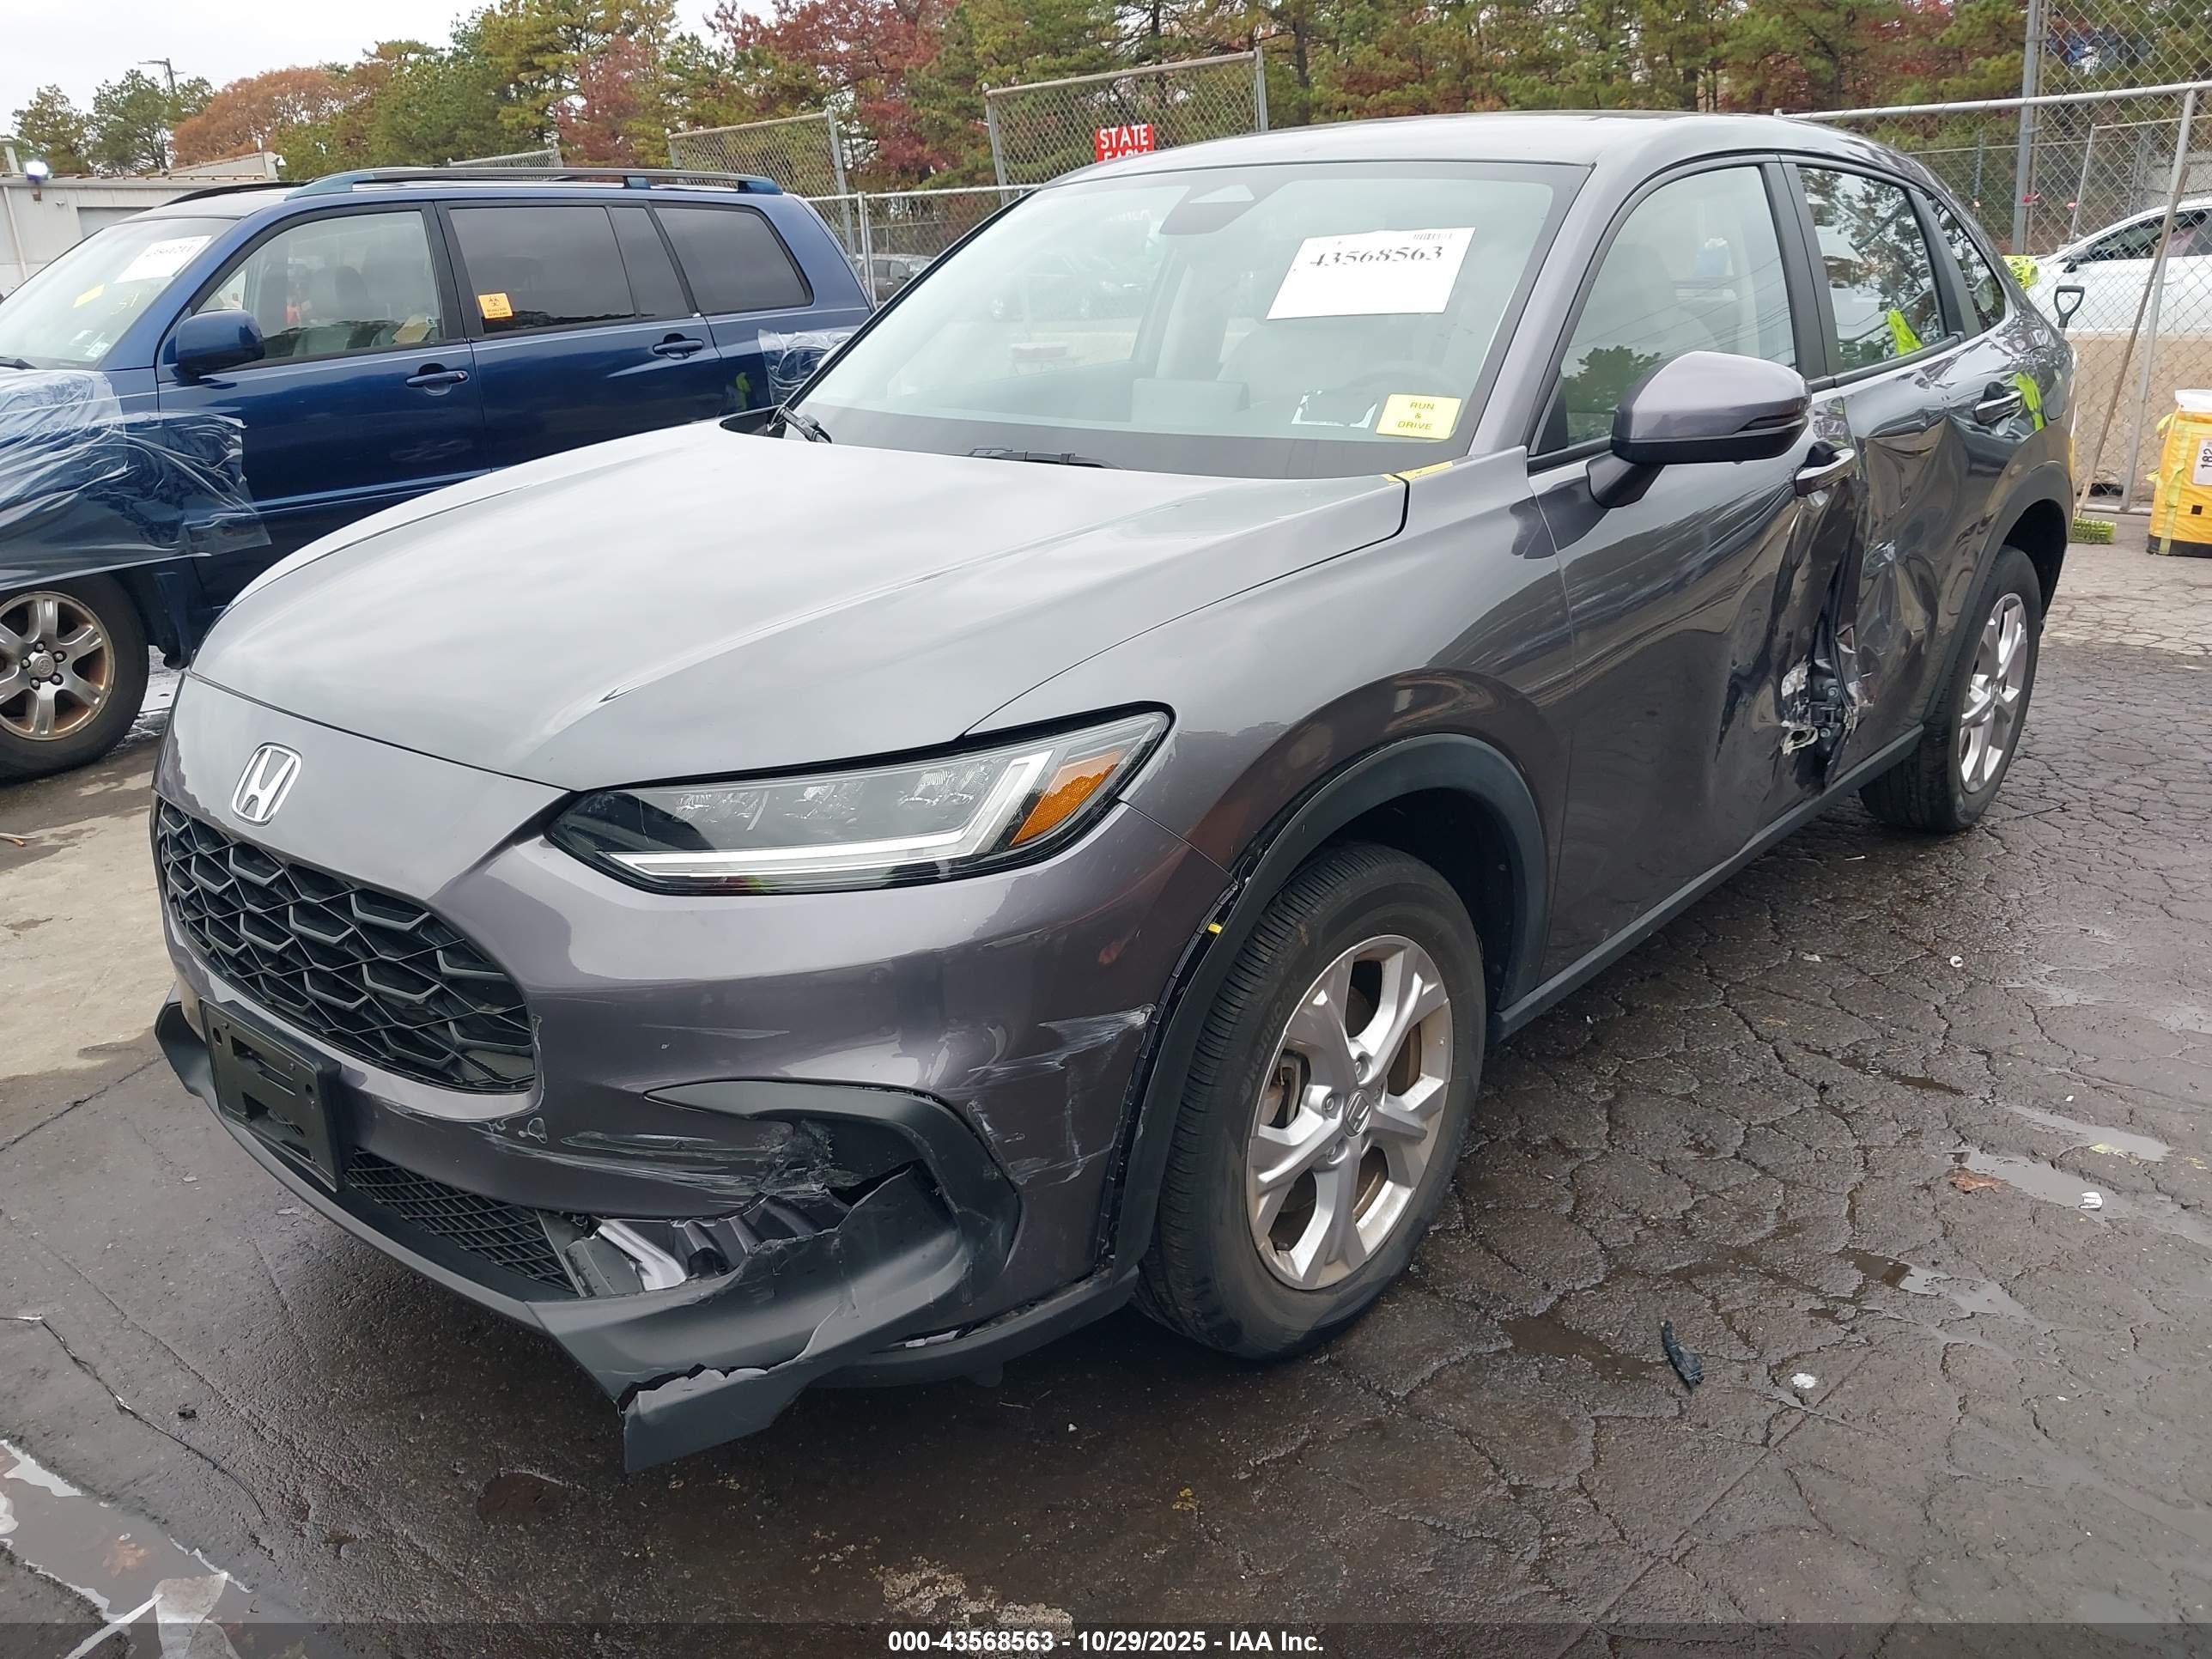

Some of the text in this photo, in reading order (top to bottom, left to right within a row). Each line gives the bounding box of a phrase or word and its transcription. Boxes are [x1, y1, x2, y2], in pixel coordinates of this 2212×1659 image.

[1099, 124, 1149, 149] STATE
[1309, 246, 1443, 267] 43568563
[1409, 401, 1435, 410] RUN
[1397, 420, 1433, 430] DRIVE
